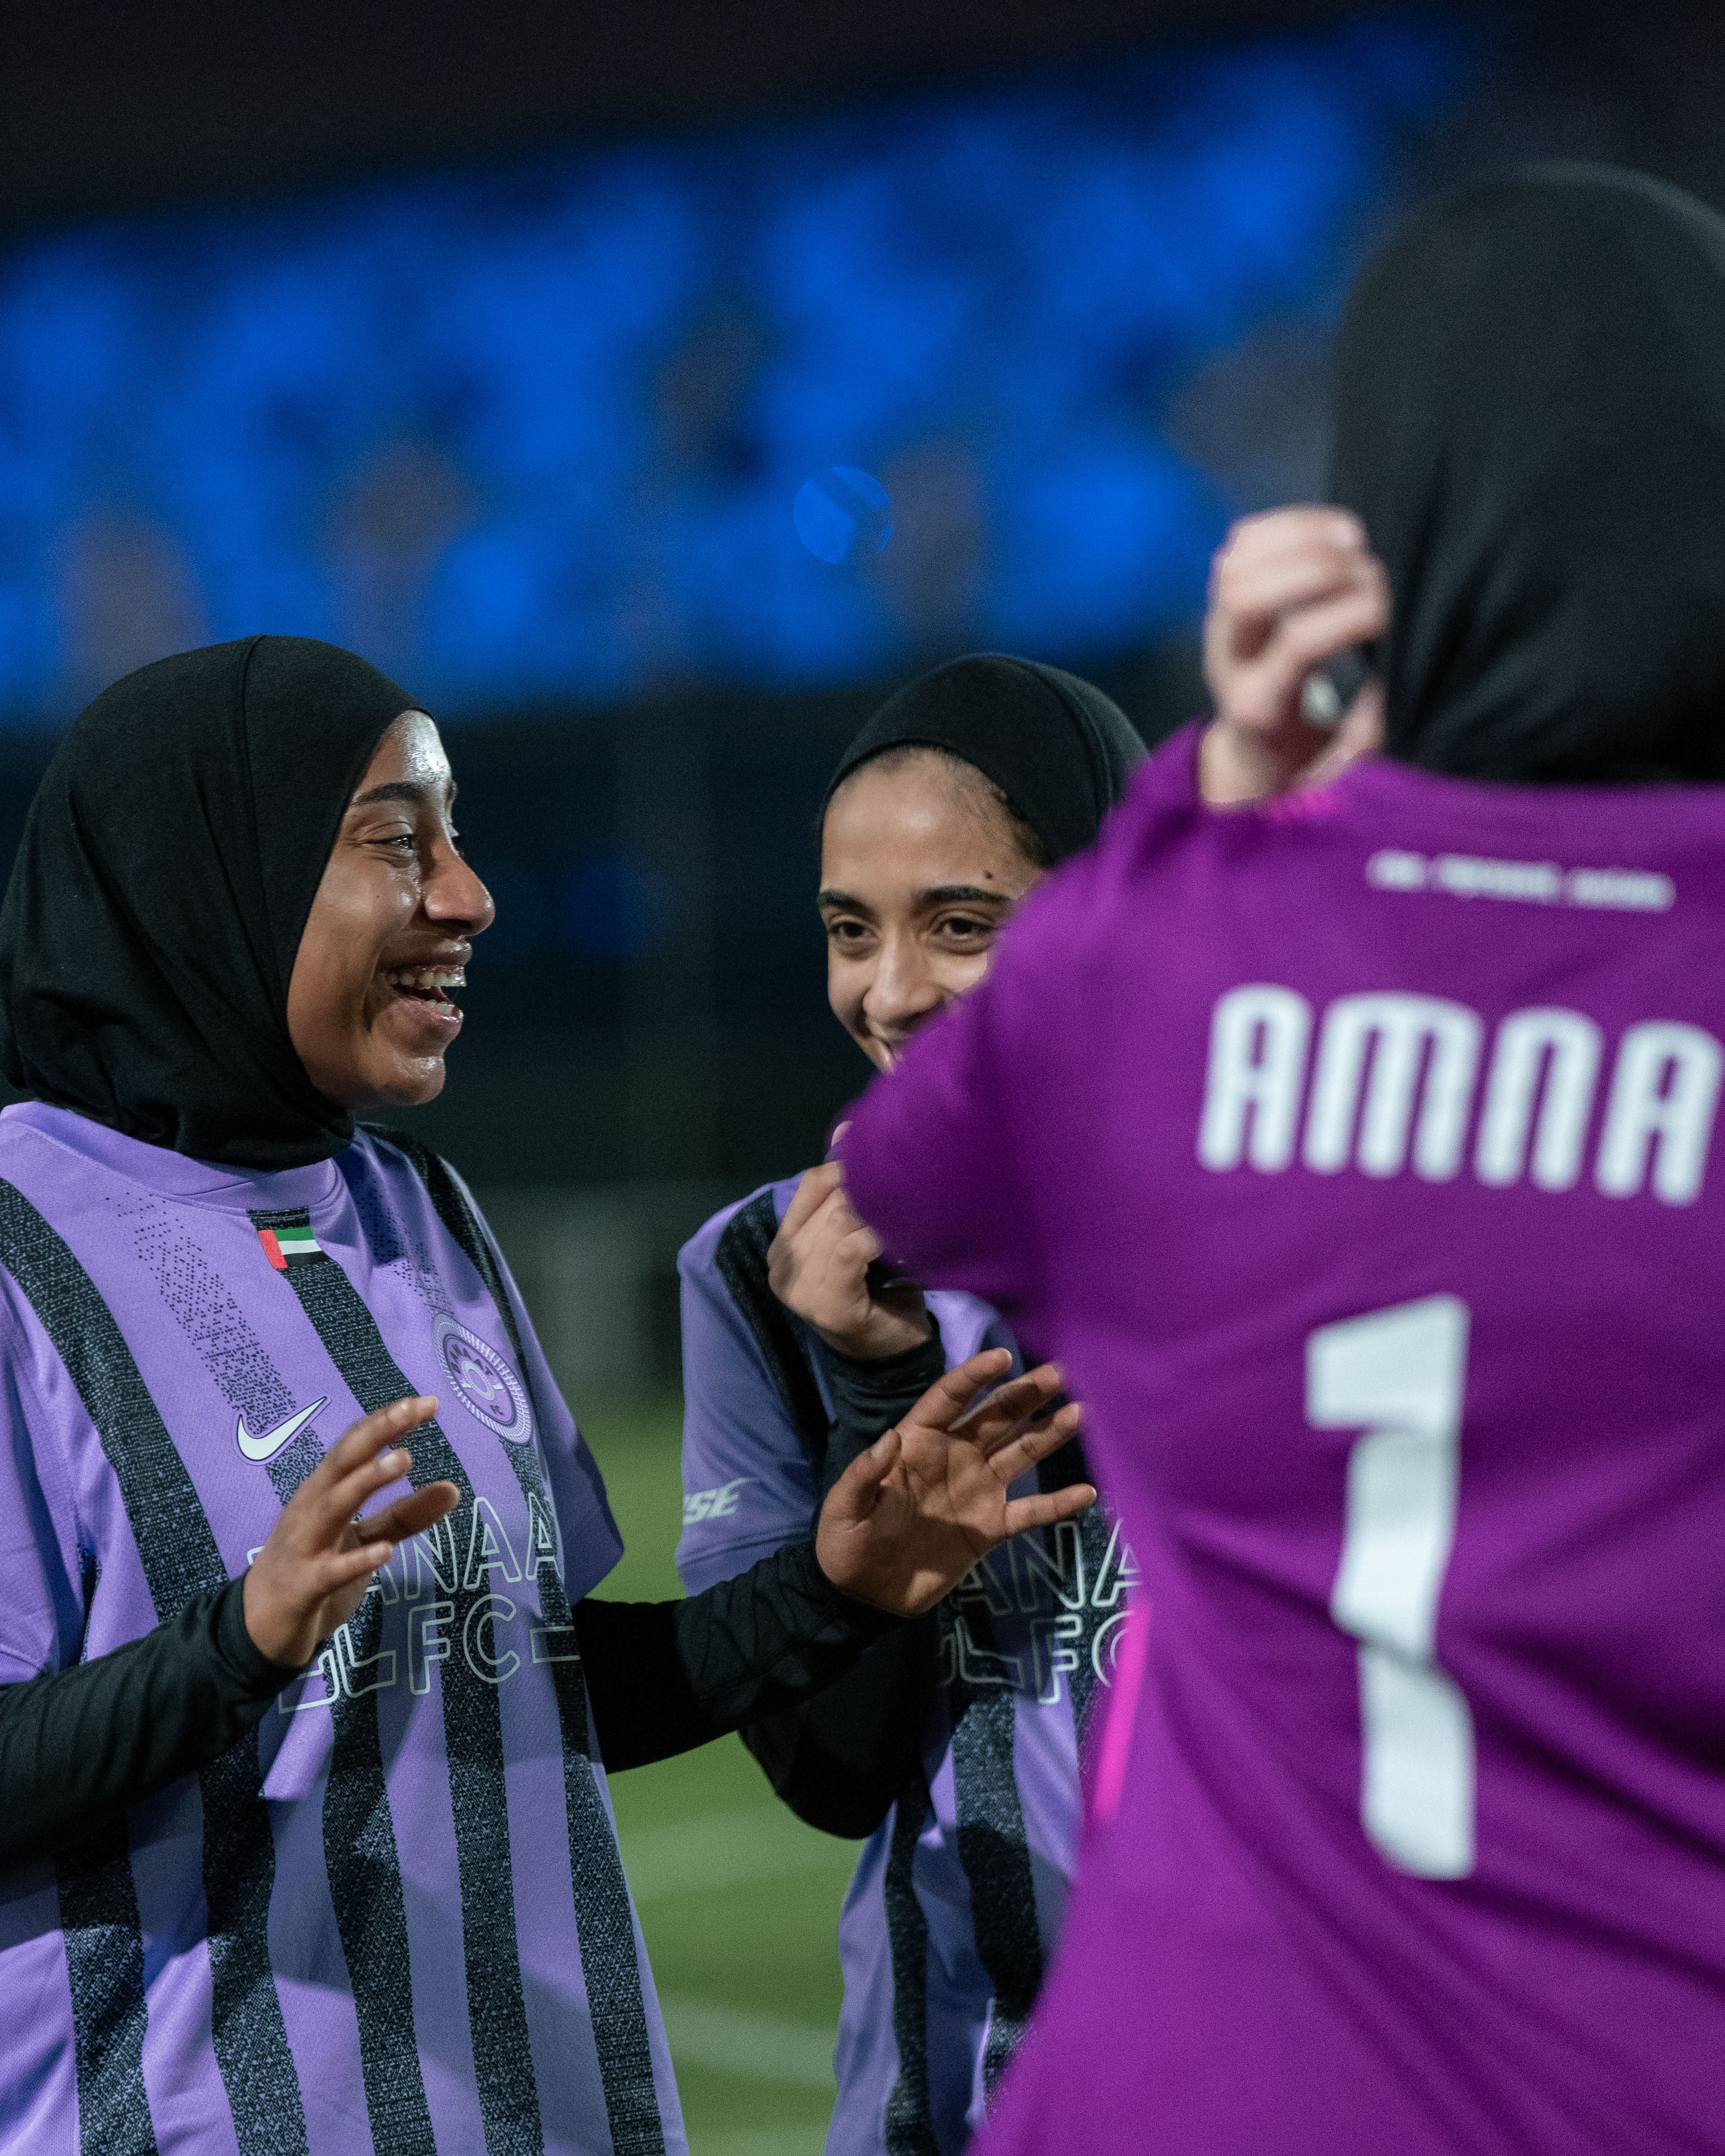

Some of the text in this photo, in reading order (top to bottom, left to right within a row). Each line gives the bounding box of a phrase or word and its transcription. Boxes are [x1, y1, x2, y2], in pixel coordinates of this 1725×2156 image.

[1198, 983, 1725, 1207] AMNA
[683, 1477, 752, 1525] SE
[1306, 1292, 1477, 1879] 1
